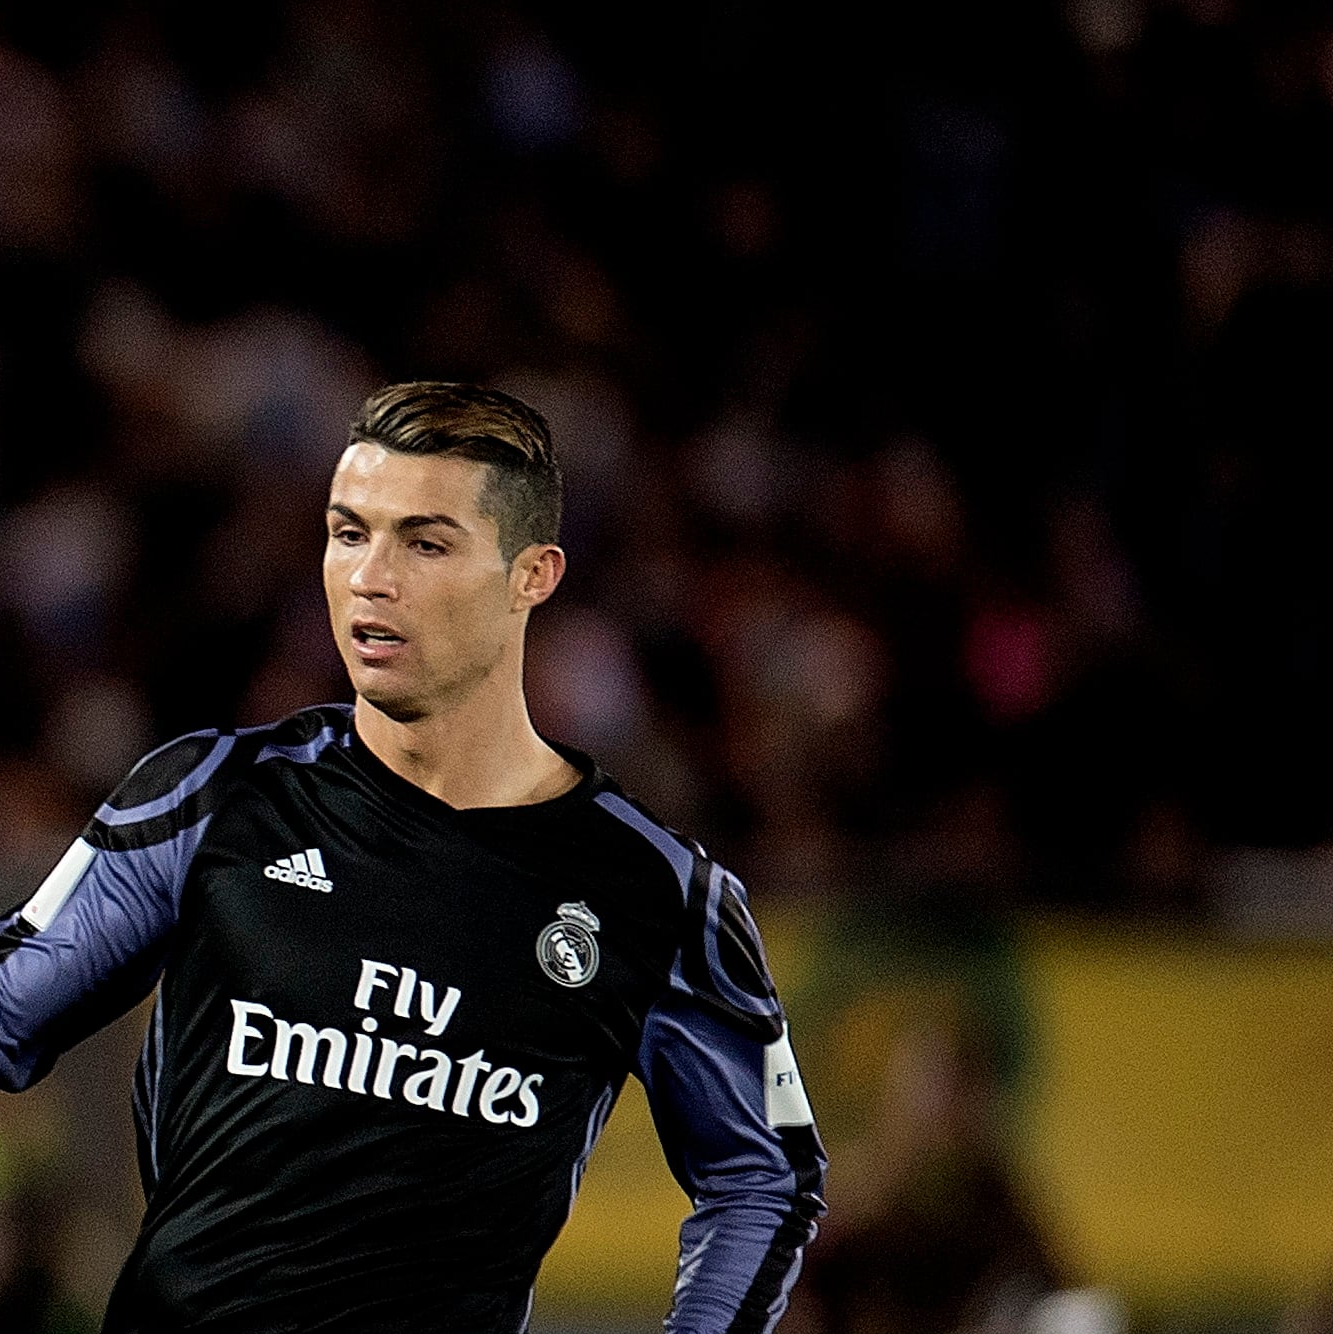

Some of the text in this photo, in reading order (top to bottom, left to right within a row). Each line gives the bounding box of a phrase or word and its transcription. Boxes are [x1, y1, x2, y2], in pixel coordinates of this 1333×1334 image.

[263, 865, 334, 893] adidas
[353, 958, 462, 1037] Fly
[226, 998, 545, 1128] Emirates
